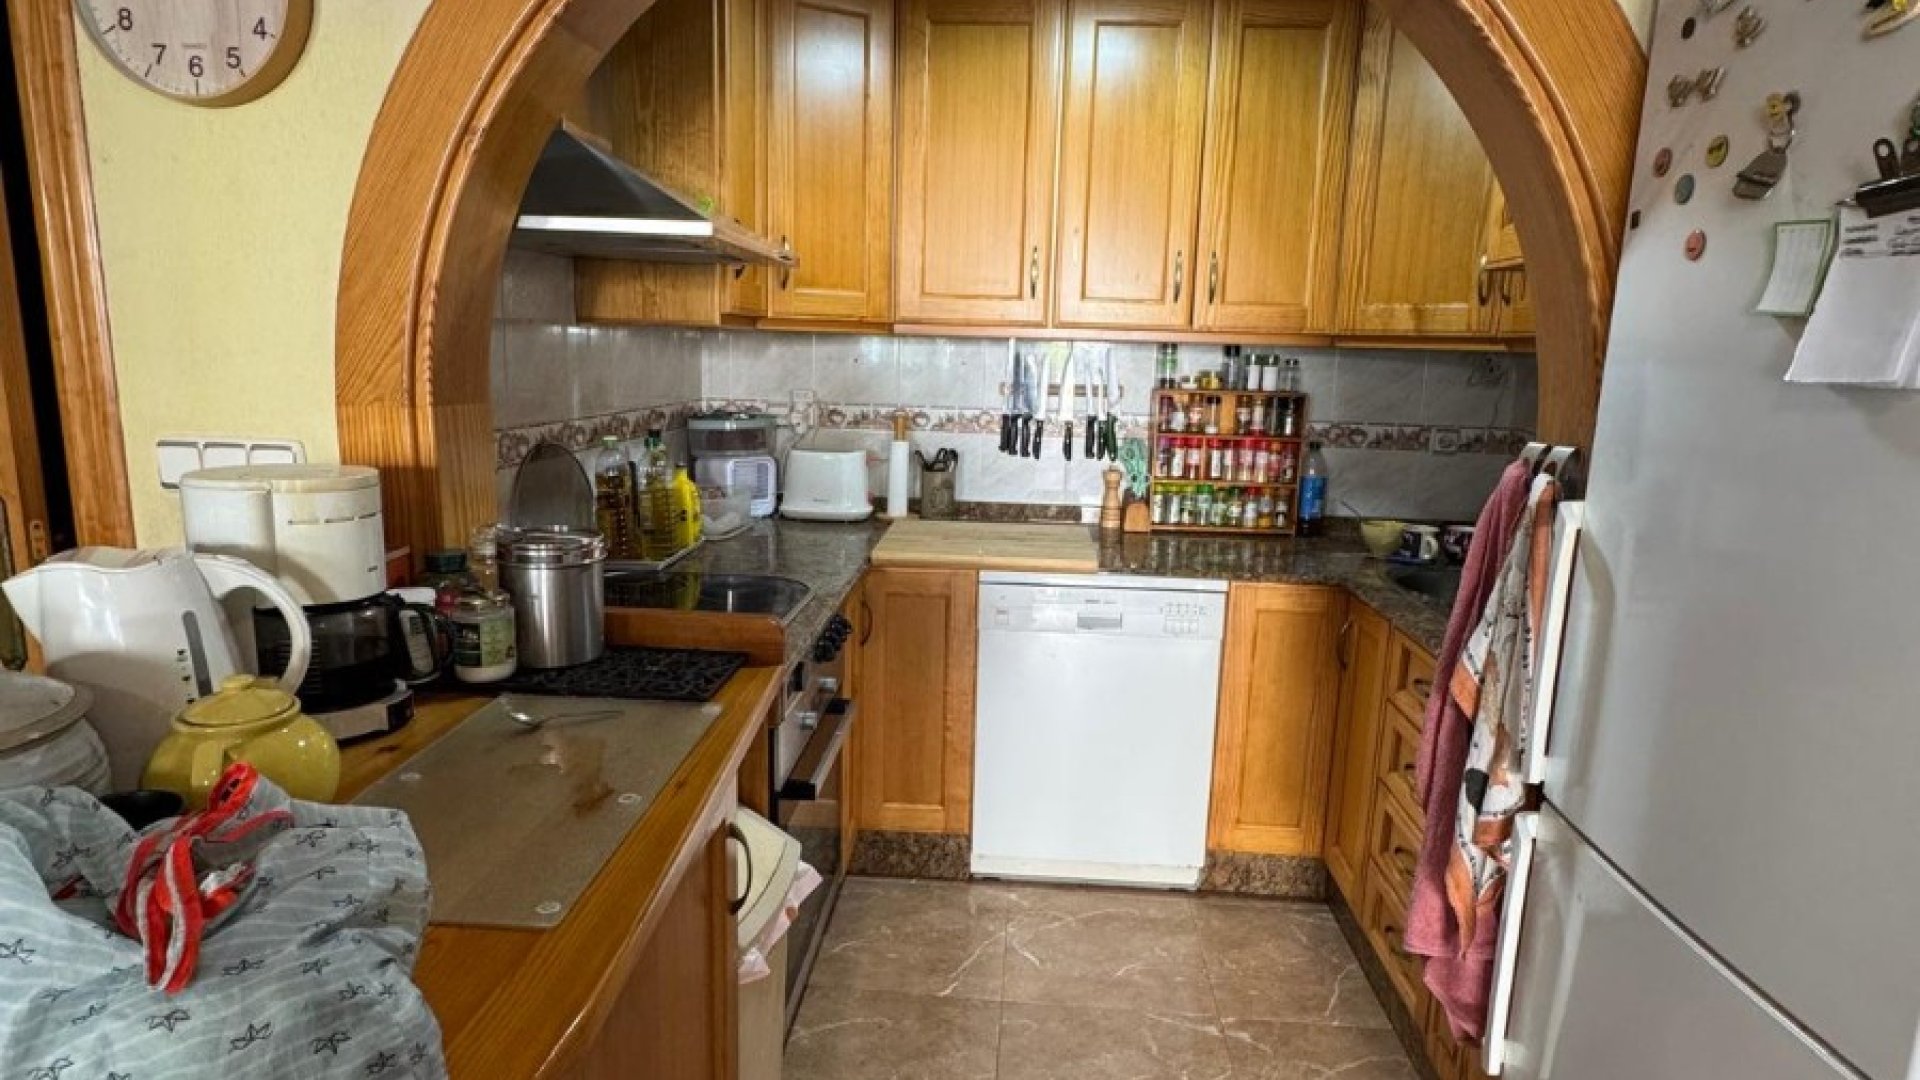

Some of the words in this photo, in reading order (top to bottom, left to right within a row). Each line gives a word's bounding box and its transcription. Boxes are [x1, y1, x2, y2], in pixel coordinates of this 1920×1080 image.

[117, 7, 133, 31] 8
[252, 16, 268, 41] 4
[152, 43, 167, 66] 7
[226, 46, 242, 69] 5
[188, 55, 204, 78] 6
